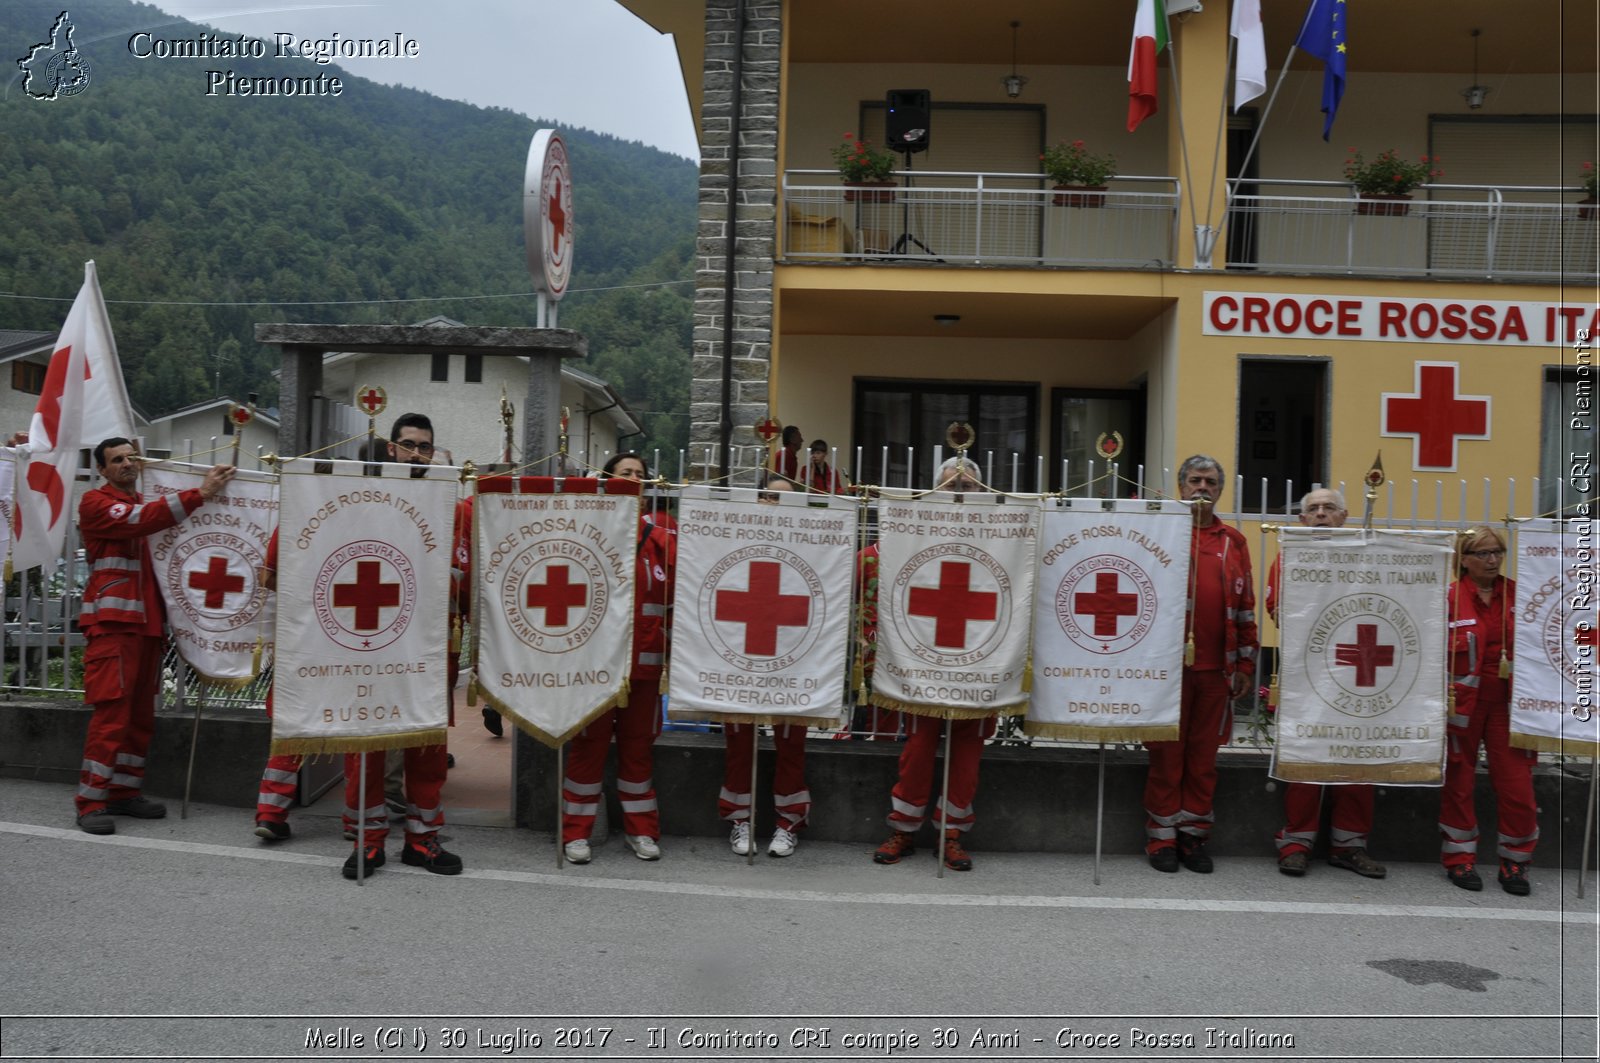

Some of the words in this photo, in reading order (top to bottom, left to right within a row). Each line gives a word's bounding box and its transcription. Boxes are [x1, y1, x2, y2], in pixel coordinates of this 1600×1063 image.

[1210, 296, 1363, 335] CROCE
[1379, 302, 1528, 341] ROSSA
[501, 499, 548, 511] VOLONTARI
[553, 500, 570, 510] DEL
[574, 501, 616, 511] SOCCORSO
[297, 501, 338, 550] CROCE
[338, 490, 392, 508] ROSSA
[394, 497, 438, 553] ITALIANA
[689, 509, 719, 522] CORPO
[724, 512, 773, 527] VOLONTARI
[777, 516, 794, 529] DEL
[798, 518, 844, 531] SOCCORSO
[887, 507, 913, 519] CORPO
[918, 510, 964, 523] VOLONTARI
[968, 513, 984, 524] DEL
[988, 513, 1029, 524] SOCCORSO
[153, 525, 188, 561] CROCE
[190, 513, 241, 529] ROSSA
[681, 523, 731, 539] CROCE
[736, 528, 784, 542] ROSSA
[789, 531, 851, 547] ITALIANA
[880, 520, 924, 536] CROCE
[930, 526, 975, 539] ROSSA
[979, 527, 1036, 539] ITALIANA
[195, 534, 245, 551] GINEVRA
[244, 549, 260, 563] 22
[347, 544, 394, 560] GINEVRA
[485, 533, 519, 584] CROCE
[519, 518, 577, 540] ROSSA
[581, 523, 628, 586] ITALIANA
[538, 542, 590, 564] GINEVRA
[1042, 534, 1079, 566] CROCE
[1081, 525, 1123, 541] ROSSA
[1126, 529, 1172, 568] ITALIANA
[1527, 546, 1557, 556] CORPO
[335, 552, 348, 564] DI
[393, 554, 407, 569] 22
[520, 551, 535, 566] DI
[1089, 558, 1131, 573] GINEVRA
[1298, 551, 1326, 564] CORPO
[1328, 553, 1373, 565] VOLONTARI
[1377, 554, 1390, 565] DEL
[1391, 554, 1434, 565] SOCCORSO
[590, 564, 602, 578] 22
[704, 547, 772, 590] CONVENZIONE
[776, 548, 787, 560] DI
[789, 556, 823, 597] GINEVRA
[896, 545, 962, 587] CONVENZIONE
[966, 546, 978, 557] DI
[978, 552, 1011, 593] GINEVRA
[1078, 564, 1089, 576] DI
[1131, 567, 1145, 582] 22
[1291, 568, 1332, 583] CROCE
[1337, 569, 1382, 584] ROSSA
[1387, 571, 1437, 584] ITALIANA
[316, 560, 339, 636] CONVENZIONE
[402, 567, 415, 612] AGOSTO
[505, 567, 544, 647] CONVENZIONE
[589, 582, 606, 625] AGOSTO
[1057, 573, 1081, 640] CONVENZIONE
[1139, 579, 1156, 623] AGOSTO
[1523, 576, 1561, 623] CROCE
[392, 614, 408, 635] 1864
[1129, 622, 1149, 642] 1864
[1309, 597, 1373, 654] CONVENZIONE
[1377, 599, 1389, 614] DI
[1390, 608, 1418, 656] GINEVRA
[566, 626, 591, 647] 1864
[212, 640, 276, 653] SAMPEYR
[298, 664, 372, 678] COMITATO
[377, 662, 426, 675] LOCALE
[501, 670, 610, 688] SAVIGLIANO
[886, 662, 944, 681] COMITATO
[948, 671, 1000, 684] LOCALE
[1003, 671, 1014, 682] DI
[1043, 666, 1110, 680] COMITATO
[1117, 668, 1167, 680] LOCALE
[699, 671, 797, 688] DELEGAZIONE
[804, 678, 818, 689] DI
[357, 685, 373, 698] DI
[702, 686, 811, 706] PEVERAGNO
[901, 683, 998, 702] RACCONIGI
[1100, 686, 1111, 695] DI
[323, 705, 401, 723] BUSCA
[1068, 702, 1141, 715] DRONERO
[1518, 698, 1567, 714] GRUPPO
[1296, 724, 1362, 740] COMITATO
[1367, 725, 1411, 740] LOCALE
[1417, 726, 1430, 739] DI
[1328, 745, 1400, 759] MONESIGLIO
